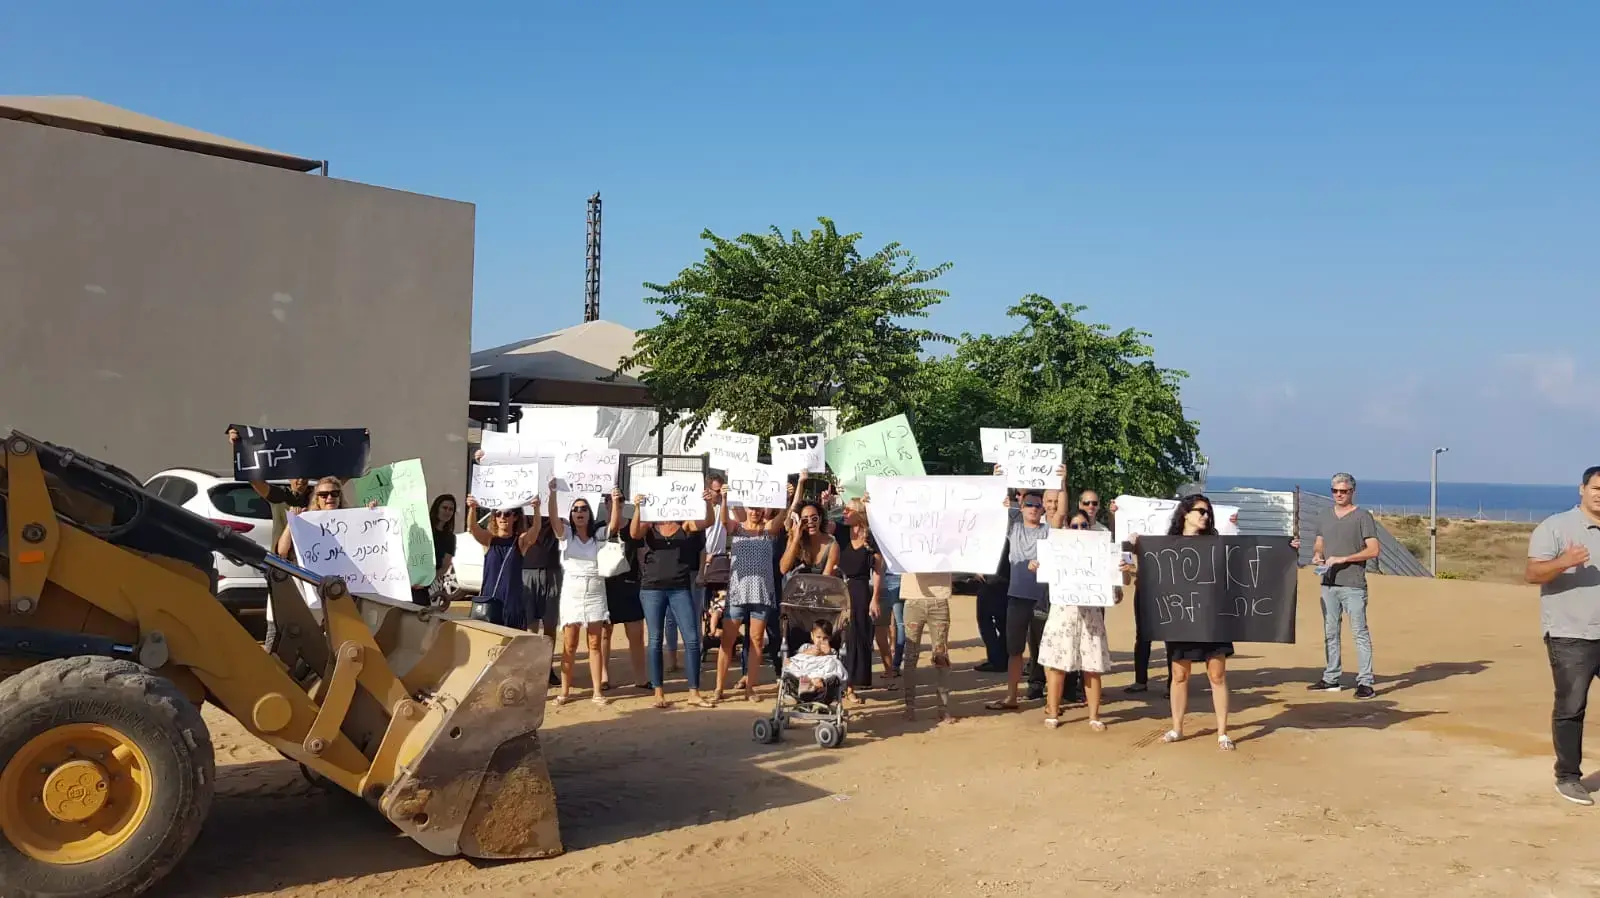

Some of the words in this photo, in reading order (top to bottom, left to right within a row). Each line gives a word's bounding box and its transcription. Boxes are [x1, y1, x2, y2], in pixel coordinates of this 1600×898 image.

[307, 435, 344, 448] את
[776, 435, 819, 452] סכנה
[324, 546, 346, 561] את
[352, 542, 389, 562] מסכנת
[1217, 596, 1273, 617] את
